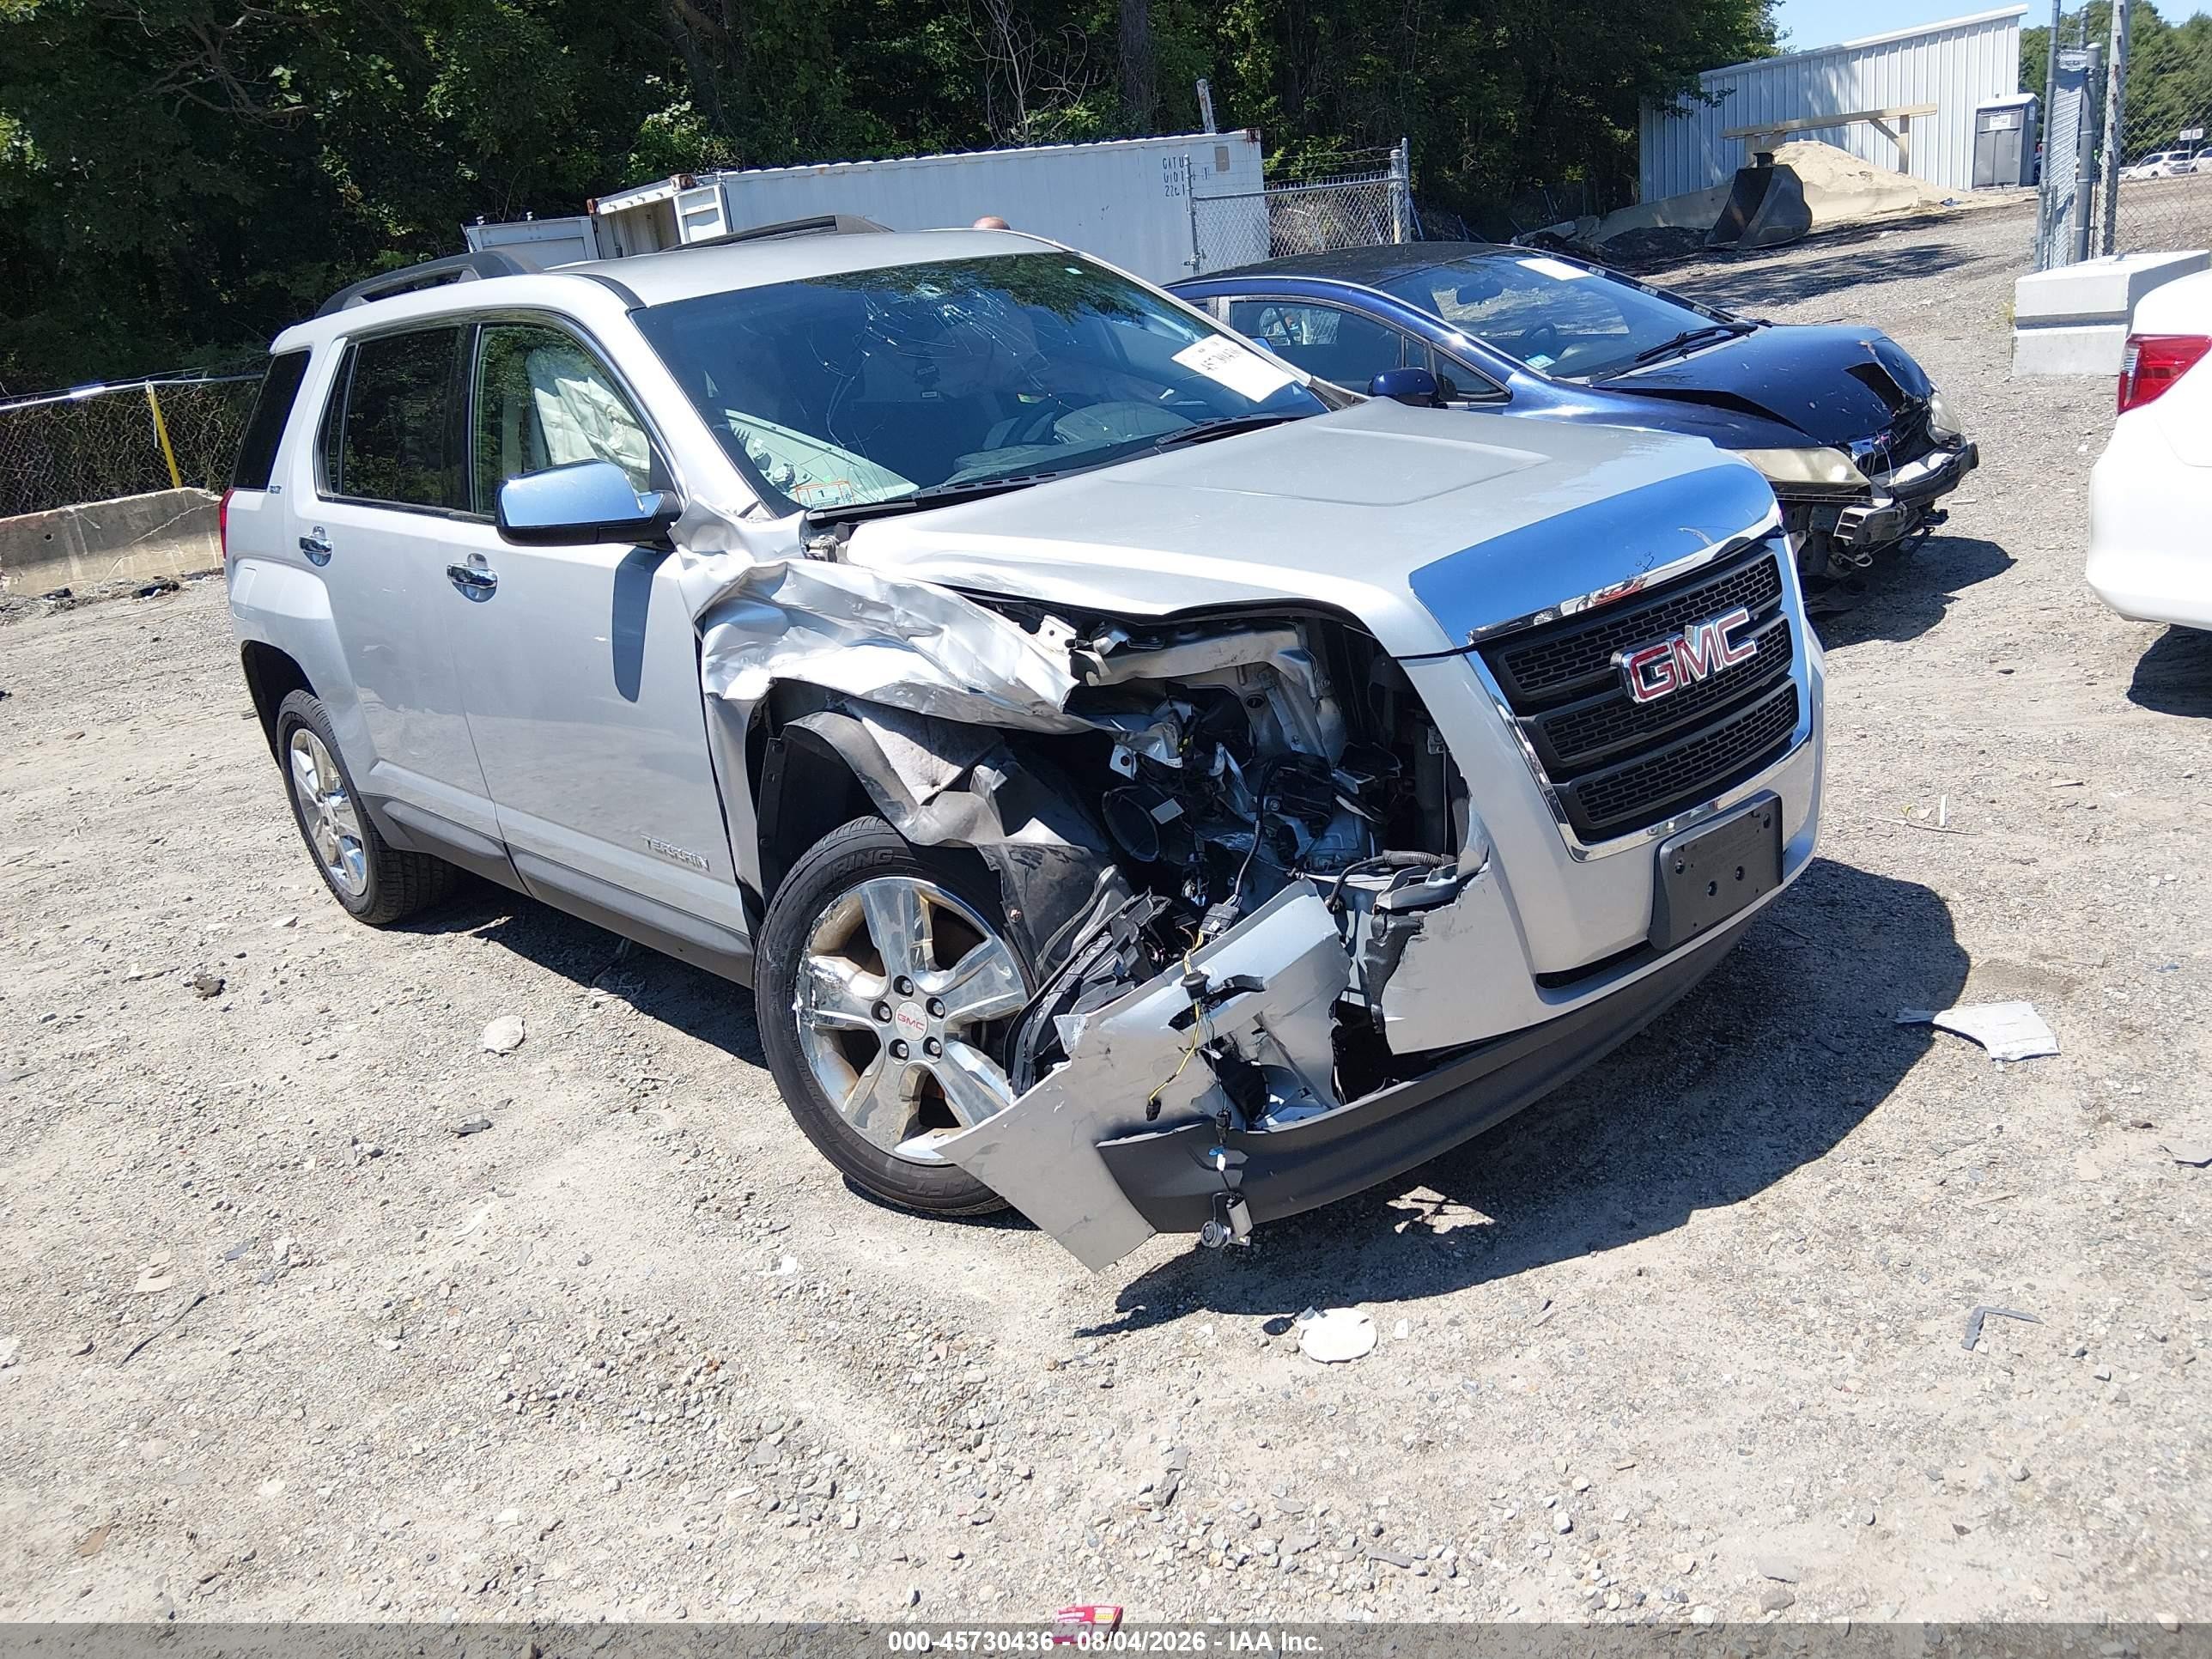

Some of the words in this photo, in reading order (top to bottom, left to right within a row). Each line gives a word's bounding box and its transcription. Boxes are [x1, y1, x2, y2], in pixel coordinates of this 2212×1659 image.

[1621, 604, 1758, 704] GMC
[640, 834, 710, 872] TERRAIN
[897, 1013, 925, 1032] GMC
